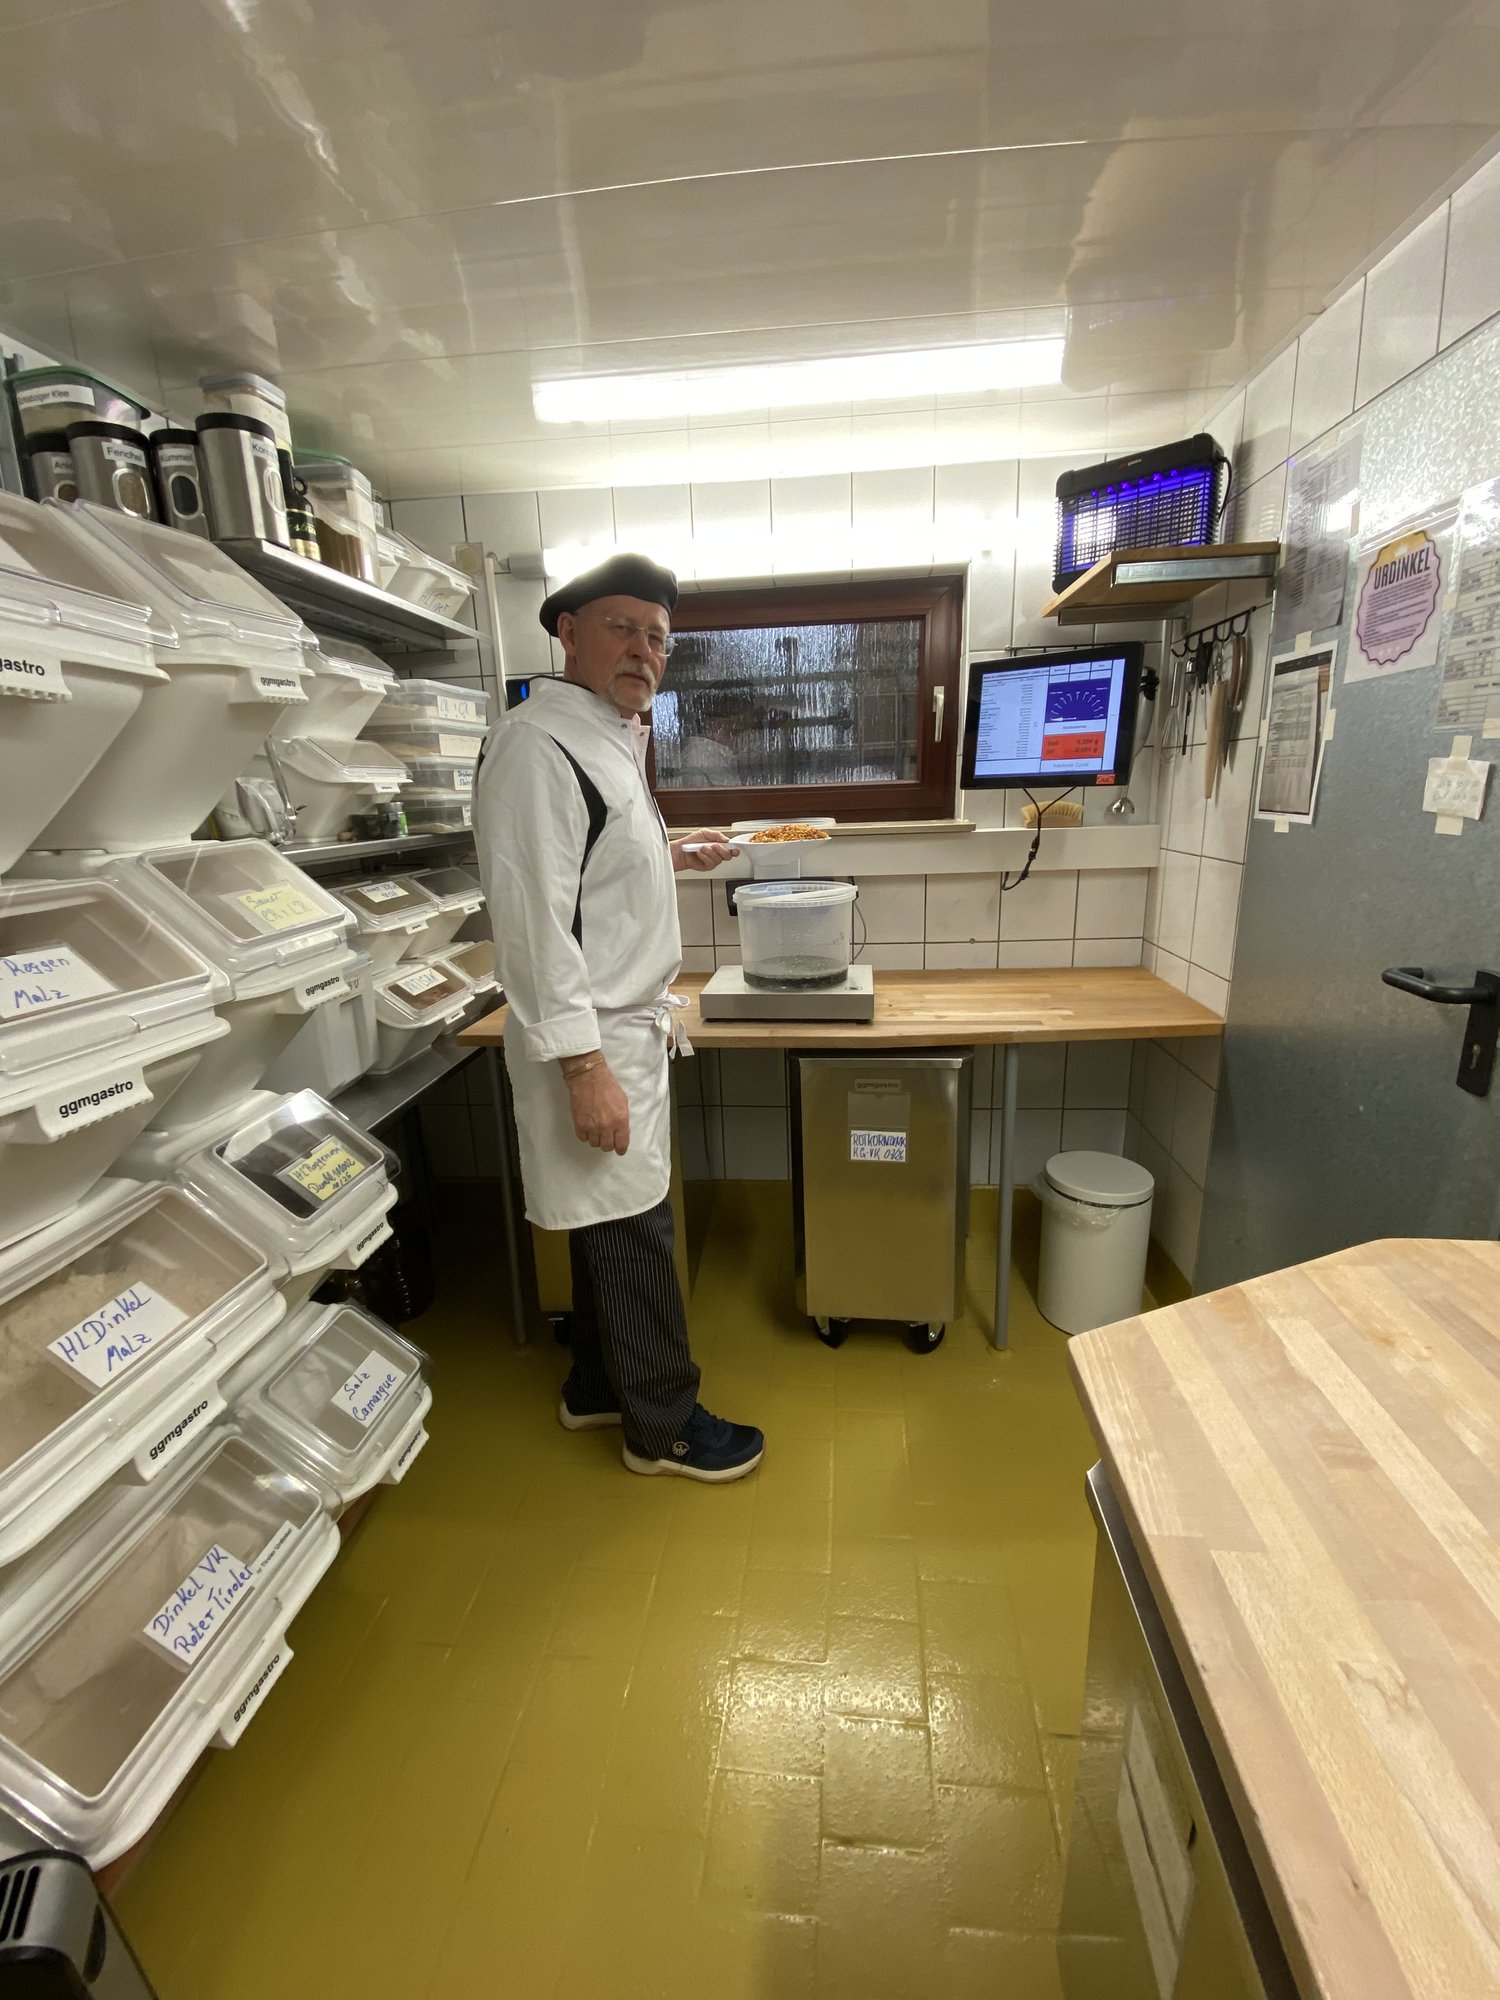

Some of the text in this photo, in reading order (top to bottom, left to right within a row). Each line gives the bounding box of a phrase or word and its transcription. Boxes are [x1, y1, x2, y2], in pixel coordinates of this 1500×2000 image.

[106, 446, 143, 462] Fenchel
[1374, 546, 1430, 590] URDINKEL
[0, 658, 45, 677] astro
[2, 957, 70, 977] Roggen
[305, 976, 340, 997] ggmgastro
[59, 1081, 133, 1118] ggmgastro
[356, 1222, 384, 1252] ggmgastro
[57, 1331, 90, 1362] HL
[344, 1372, 370, 1401] Salz
[352, 1374, 397, 1421] Camargue
[149, 1400, 208, 1460] ggmgastro
[397, 1430, 421, 1467] ggmgastro
[153, 1547, 229, 1637] Dinkel VK
[173, 1608, 214, 1654] Roter
[234, 1654, 279, 1723] ggmgastro
